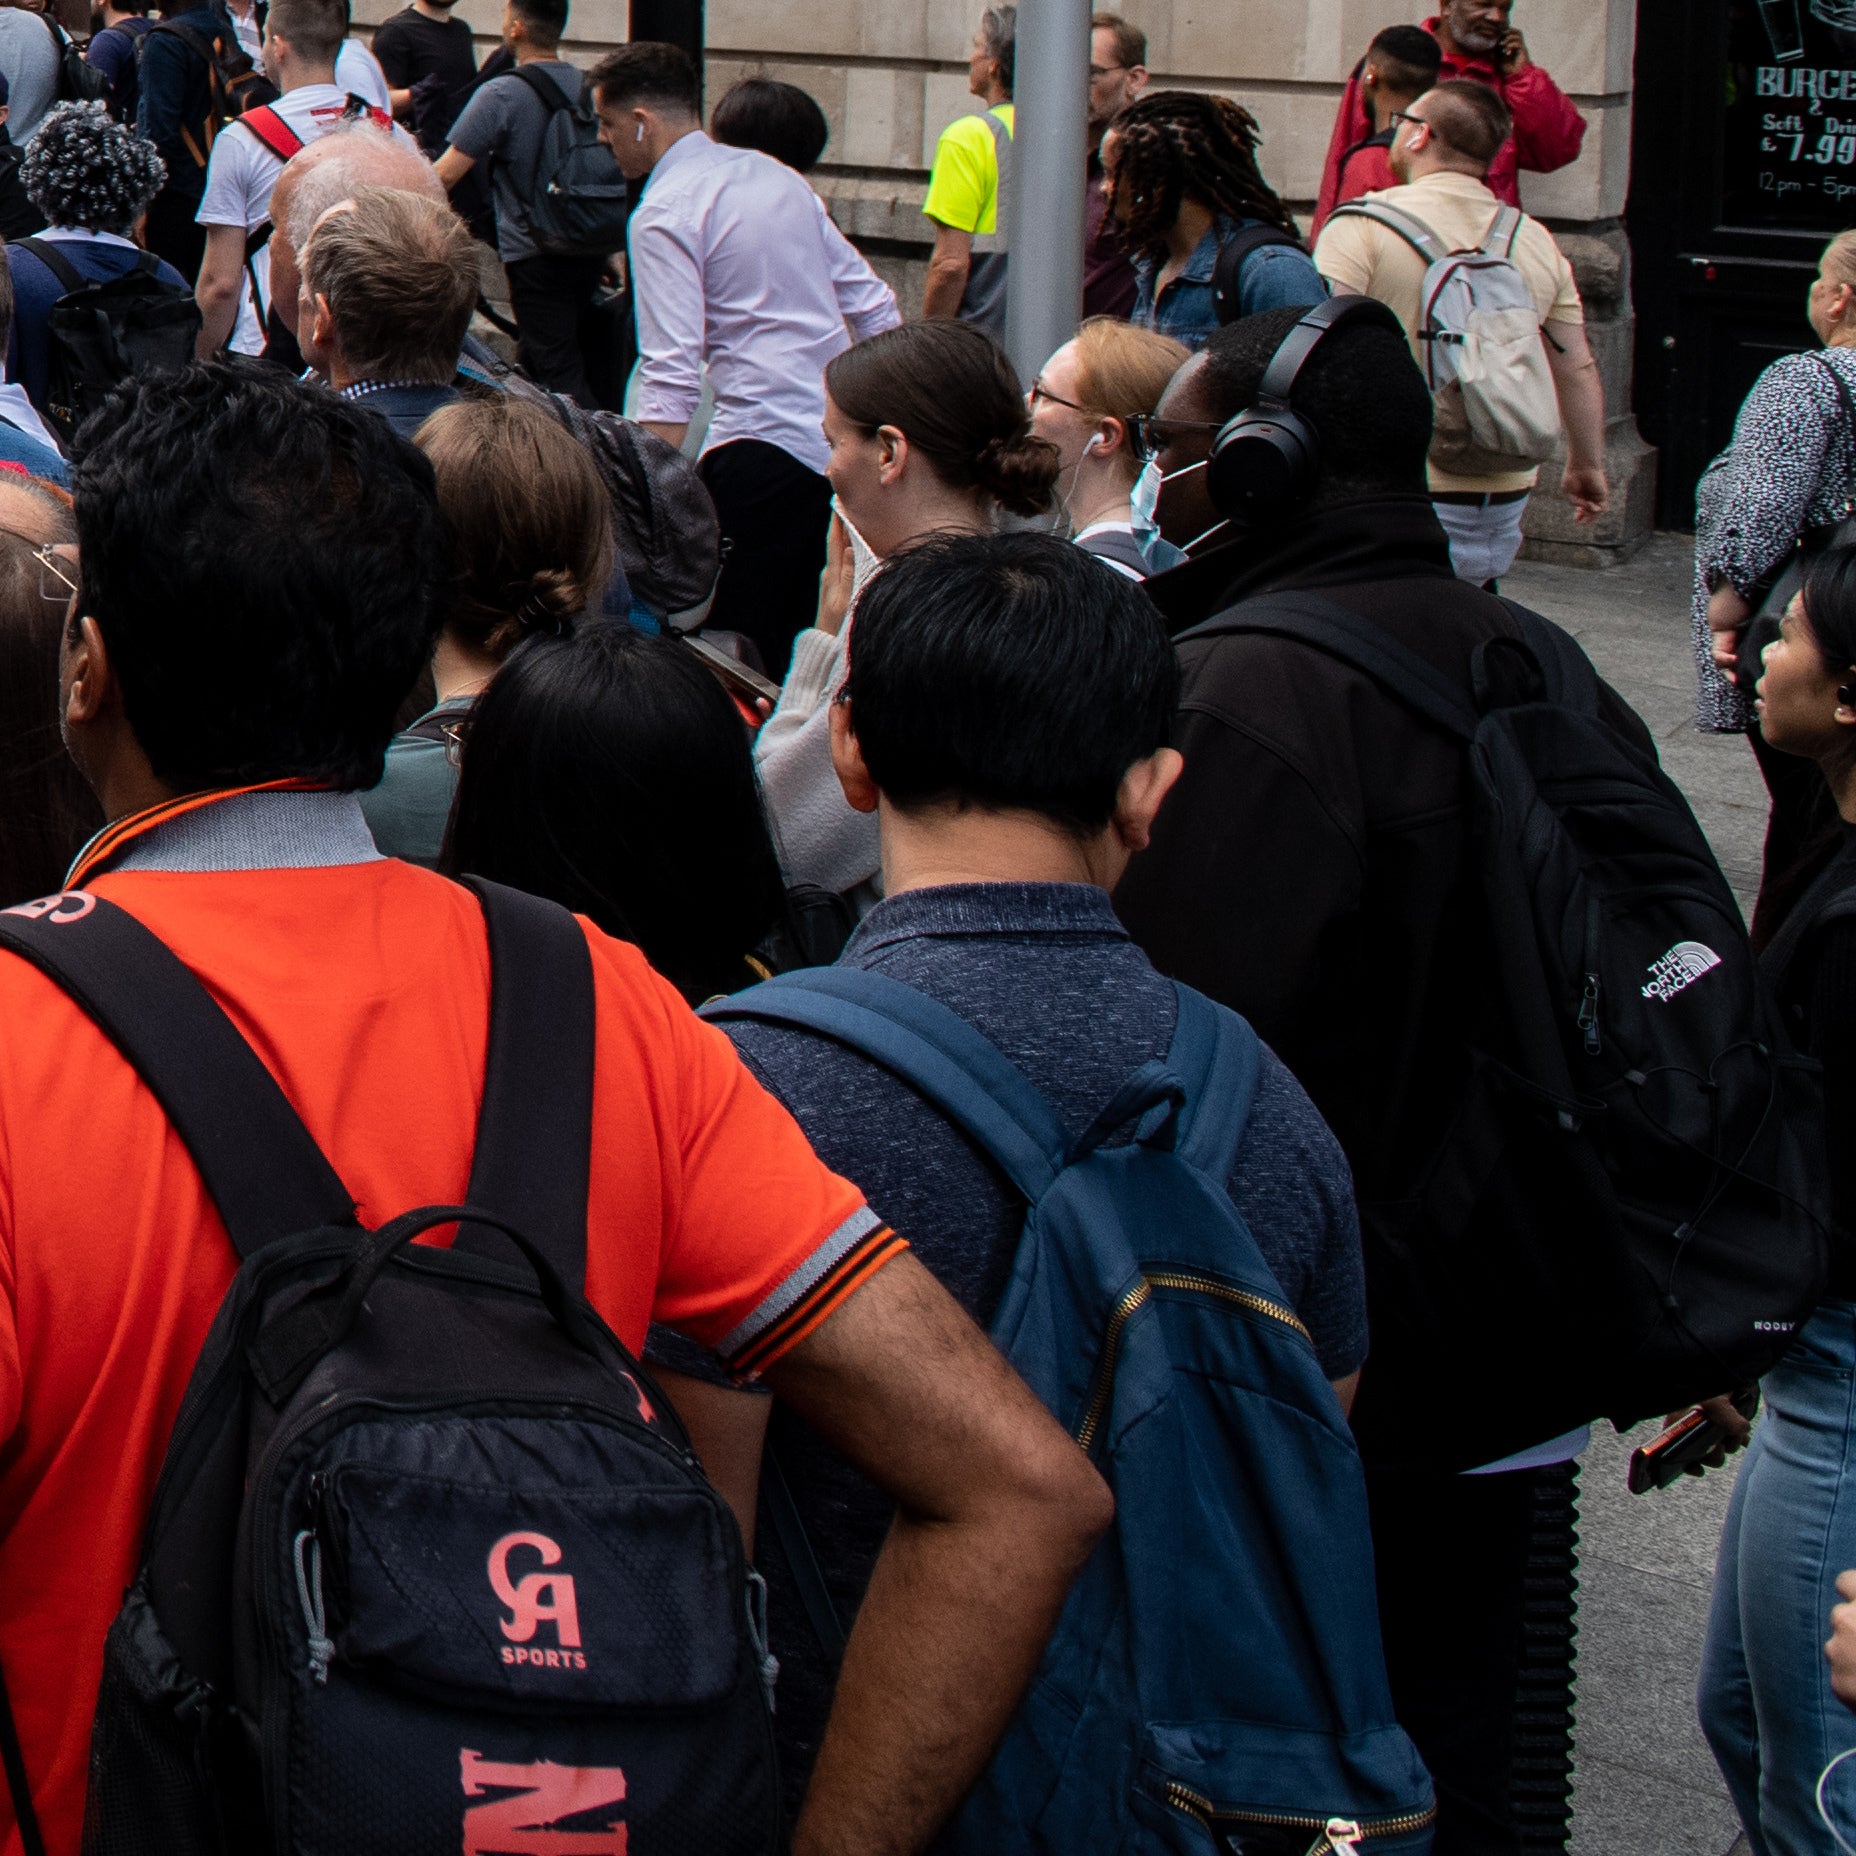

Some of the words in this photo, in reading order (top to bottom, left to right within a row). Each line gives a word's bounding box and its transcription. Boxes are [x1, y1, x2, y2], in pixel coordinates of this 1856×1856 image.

[1762, 113, 1805, 132] Soft
[1759, 171, 1802, 199] 12pm
[1646, 949, 1679, 976] THE
[1658, 969, 1696, 1003] FACE
[500, 1646, 587, 1670] SPORTS
